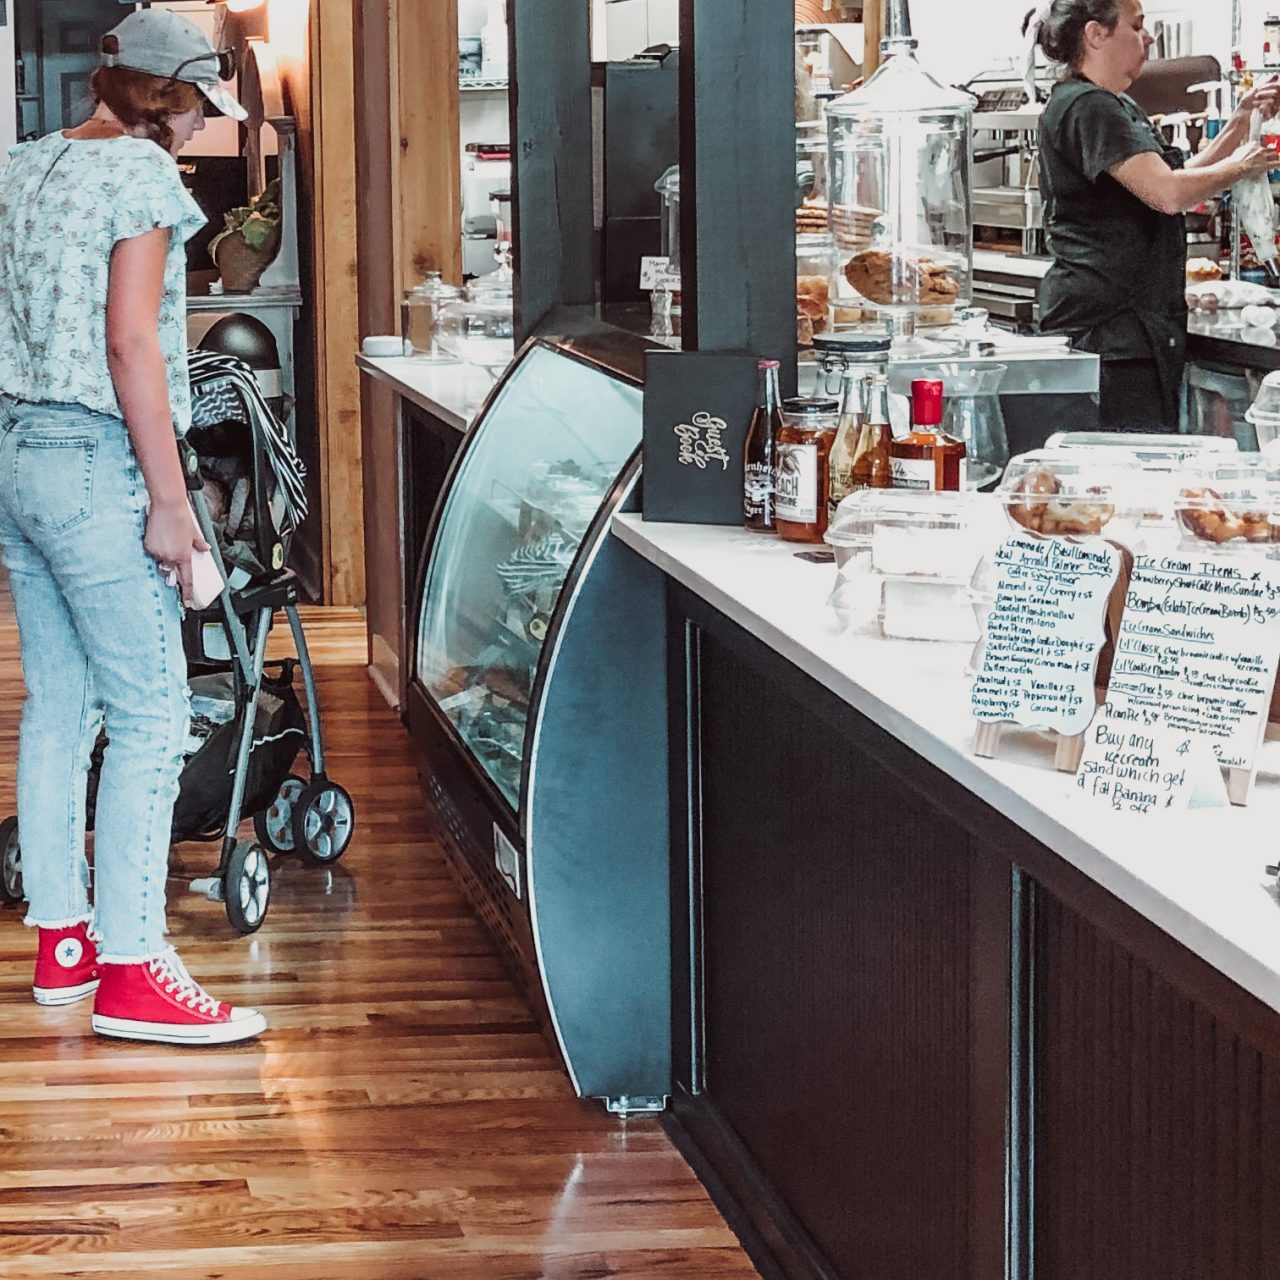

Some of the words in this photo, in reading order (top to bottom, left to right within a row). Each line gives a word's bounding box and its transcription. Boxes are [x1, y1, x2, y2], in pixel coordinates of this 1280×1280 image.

[674, 424, 706, 469] Book
[692, 411, 730, 470] Guest
[776, 477, 799, 497] EACH
[1007, 536, 1045, 554] Lemonade
[1052, 557, 1084, 571] Palmer
[1136, 555, 1156, 568] Ice
[1161, 557, 1191, 571] Cream
[1199, 562, 1241, 578] Items
[1096, 725, 1125, 750] Buy
[1129, 734, 1154, 757] any
[1163, 770, 1186, 791] get
[1114, 782, 1157, 806] Banana
[1130, 804, 1150, 815] off
